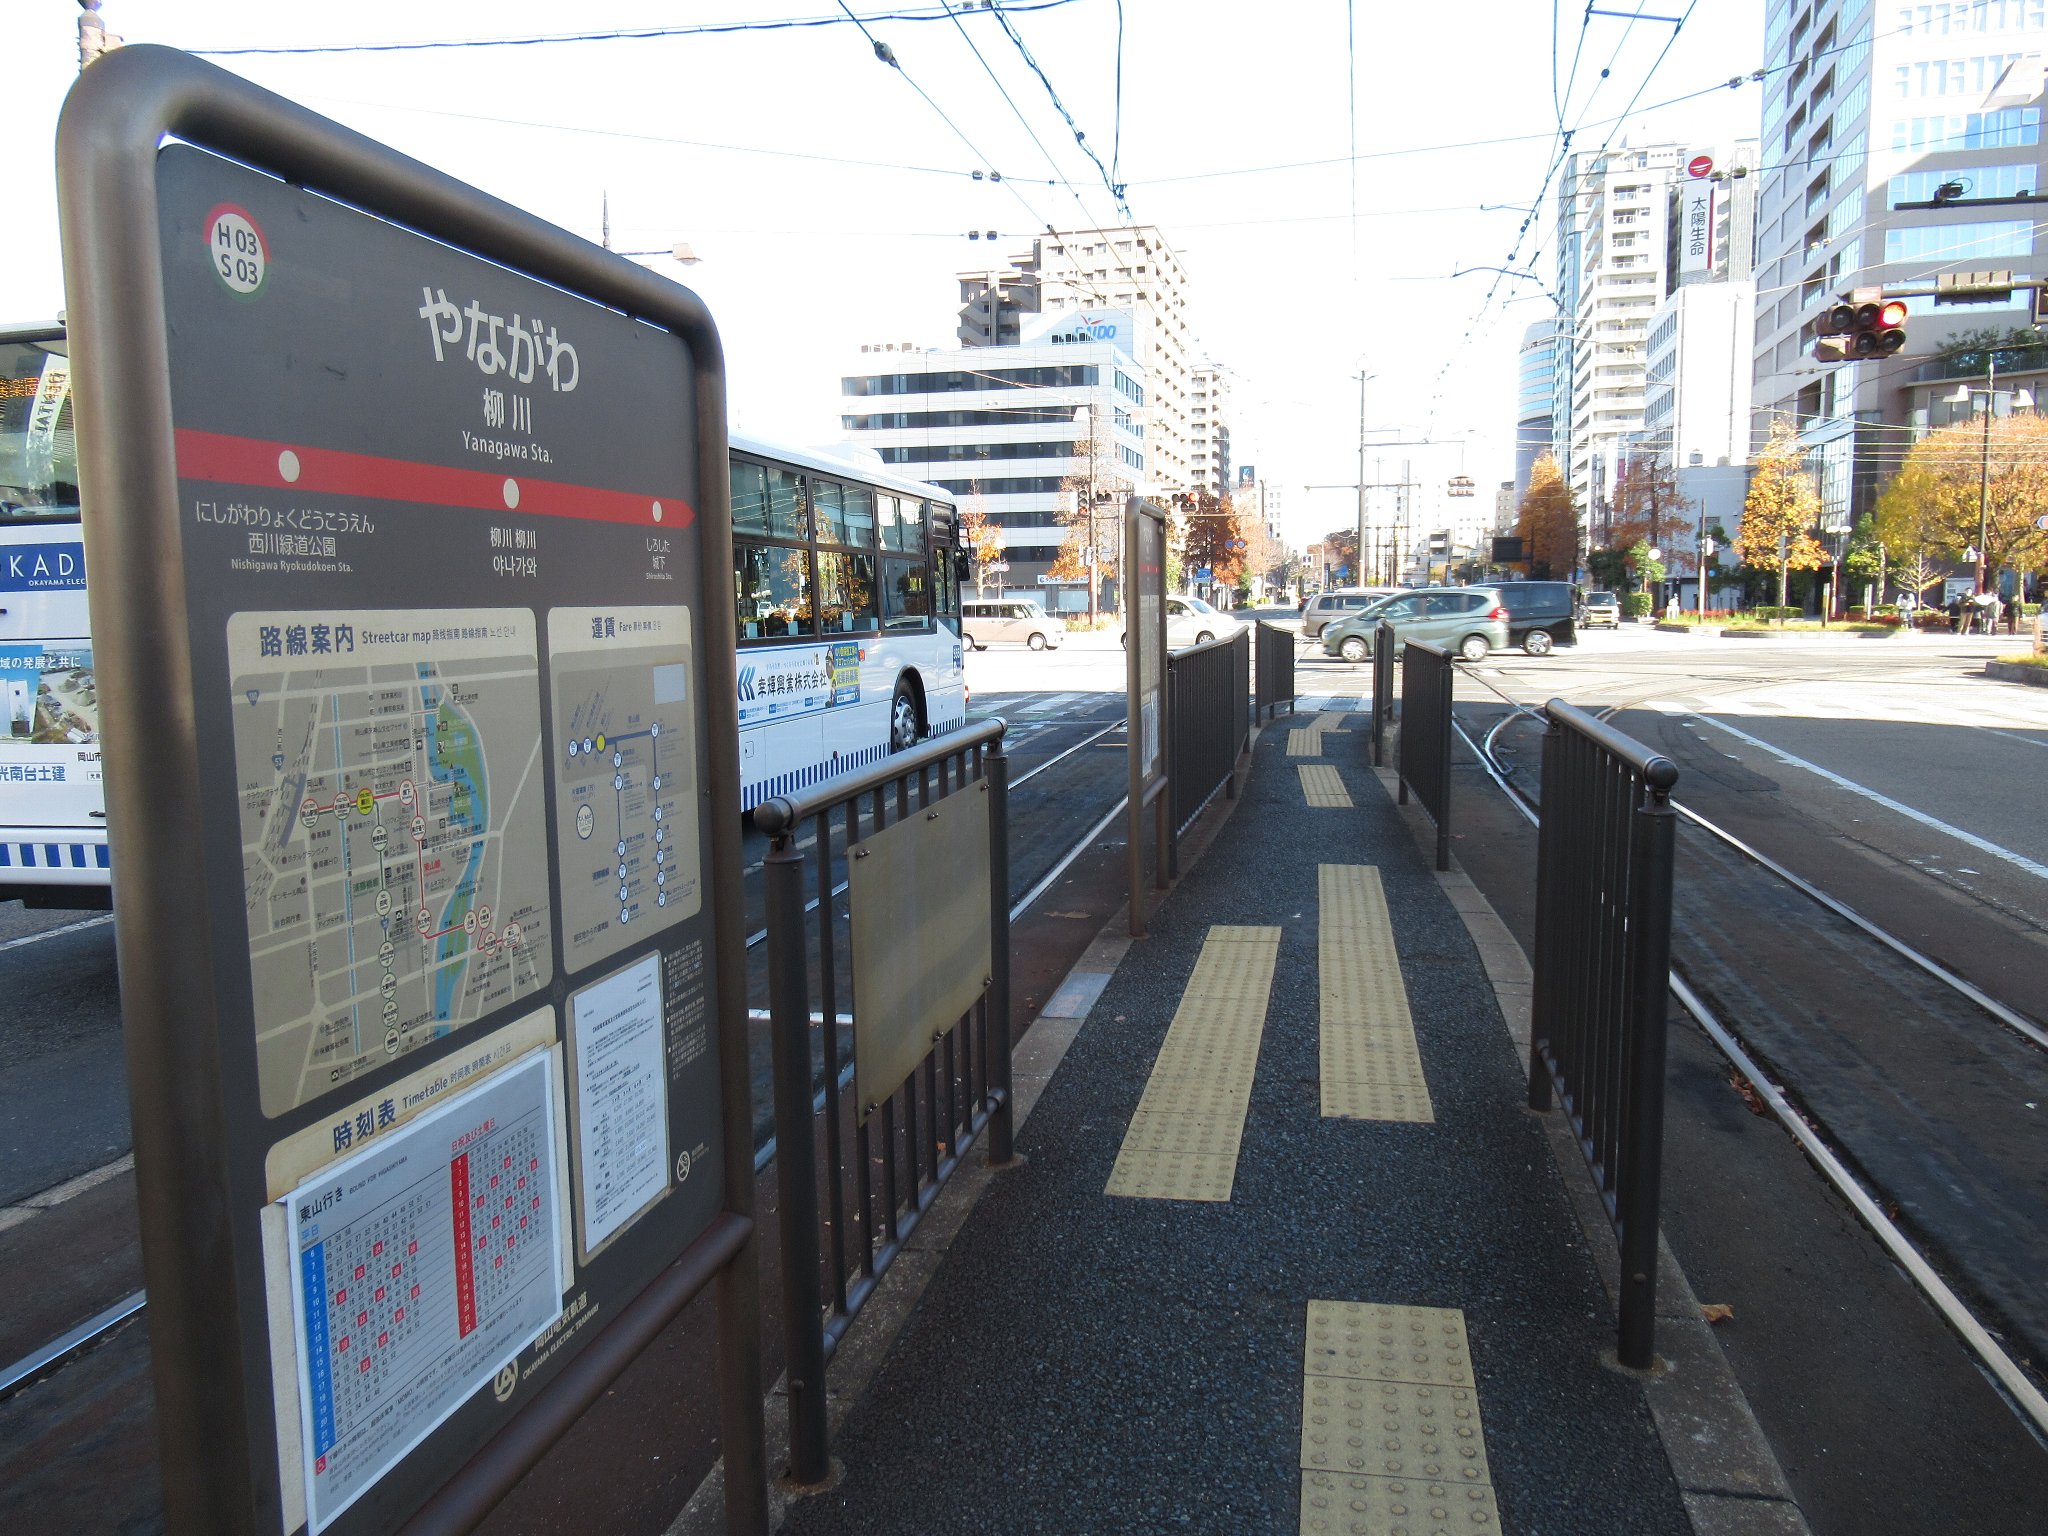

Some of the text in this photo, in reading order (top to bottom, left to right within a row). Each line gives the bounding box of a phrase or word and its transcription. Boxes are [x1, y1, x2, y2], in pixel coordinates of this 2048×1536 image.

[218, 223, 258, 255] H 03
[1690, 196, 1707, 256] 太陽生命
[221, 254, 259, 286] S 03
[419, 287, 580, 392] やながわ
[483, 388, 533, 435] 柳川
[463, 431, 553, 464] Yanagawa Sta.
[196, 501, 375, 534] にしがわりょくどうこうえん
[248, 533, 337, 557] 西川緑道公園
[646, 538, 671, 553] しろした
[231, 559, 353, 573] Nishigawa Ryokudokoen Sta.
[493, 555, 537, 577] 야나가와
[652, 555, 666, 570] 城下
[29, 579, 64, 587] OKAYAMA
[259, 624, 354, 657] 路線案内
[362, 630, 431, 644] Streetcar map
[592, 617, 615, 639] 運賃
[619, 622, 632, 632] Fare
[78, 752, 102, 762] 岡山市
[402, 1077, 448, 1109] Timetable
[333, 1098, 396, 1154] 時刻表
[300, 1186, 343, 1224] 東山行き
[301, 1224, 320, 1240] 平日
[522, 1350, 550, 1380] OKAYAMA
[550, 1328, 576, 1354] ELECTRIC
